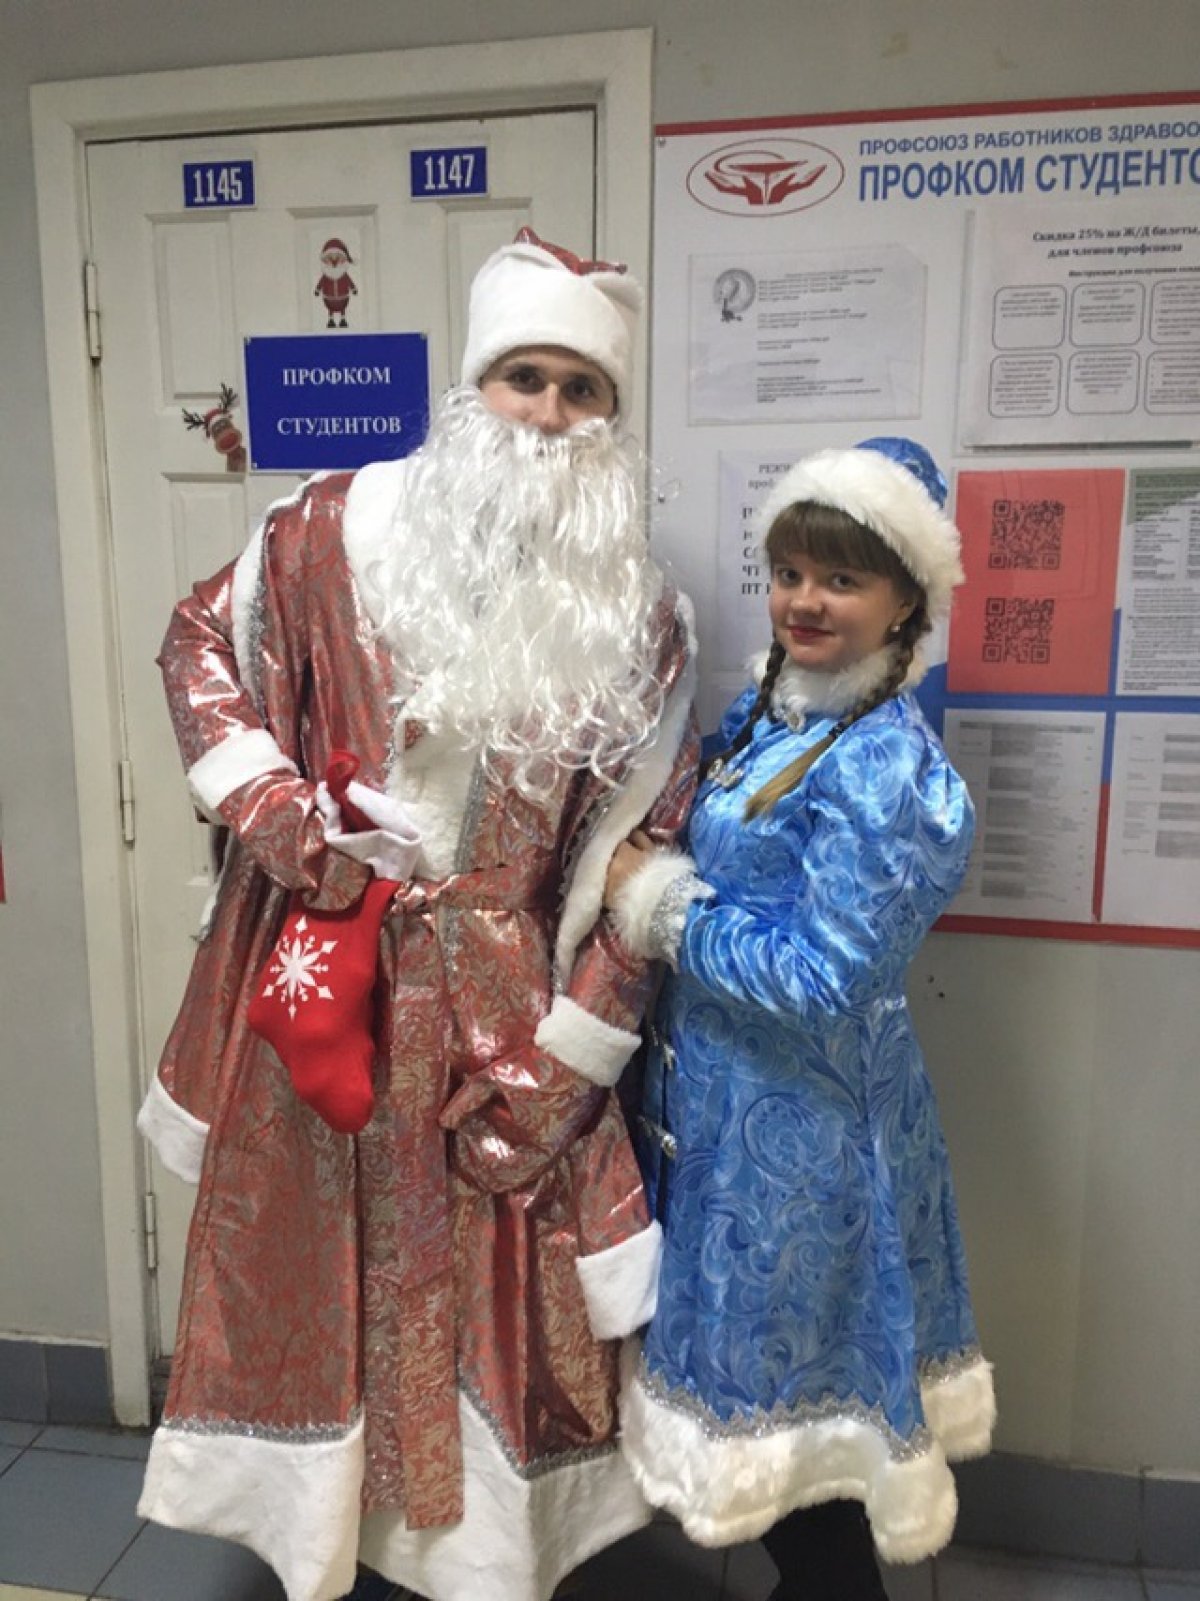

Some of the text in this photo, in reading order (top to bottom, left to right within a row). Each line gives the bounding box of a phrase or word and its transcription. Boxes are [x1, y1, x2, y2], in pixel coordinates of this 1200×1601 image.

[859, 133, 969, 156] ПРОФСОЮЗ
[974, 127, 1102, 150] РАБОТНИКОВ
[193, 167, 243, 204] 1145
[423, 153, 476, 191] 1147
[858, 156, 1025, 201] ПРОФКОМ
[1078, 228, 1104, 239] 25%
[283, 366, 391, 386] ПРОФКОМ
[276, 417, 402, 437] СТУДЕНТОВ
